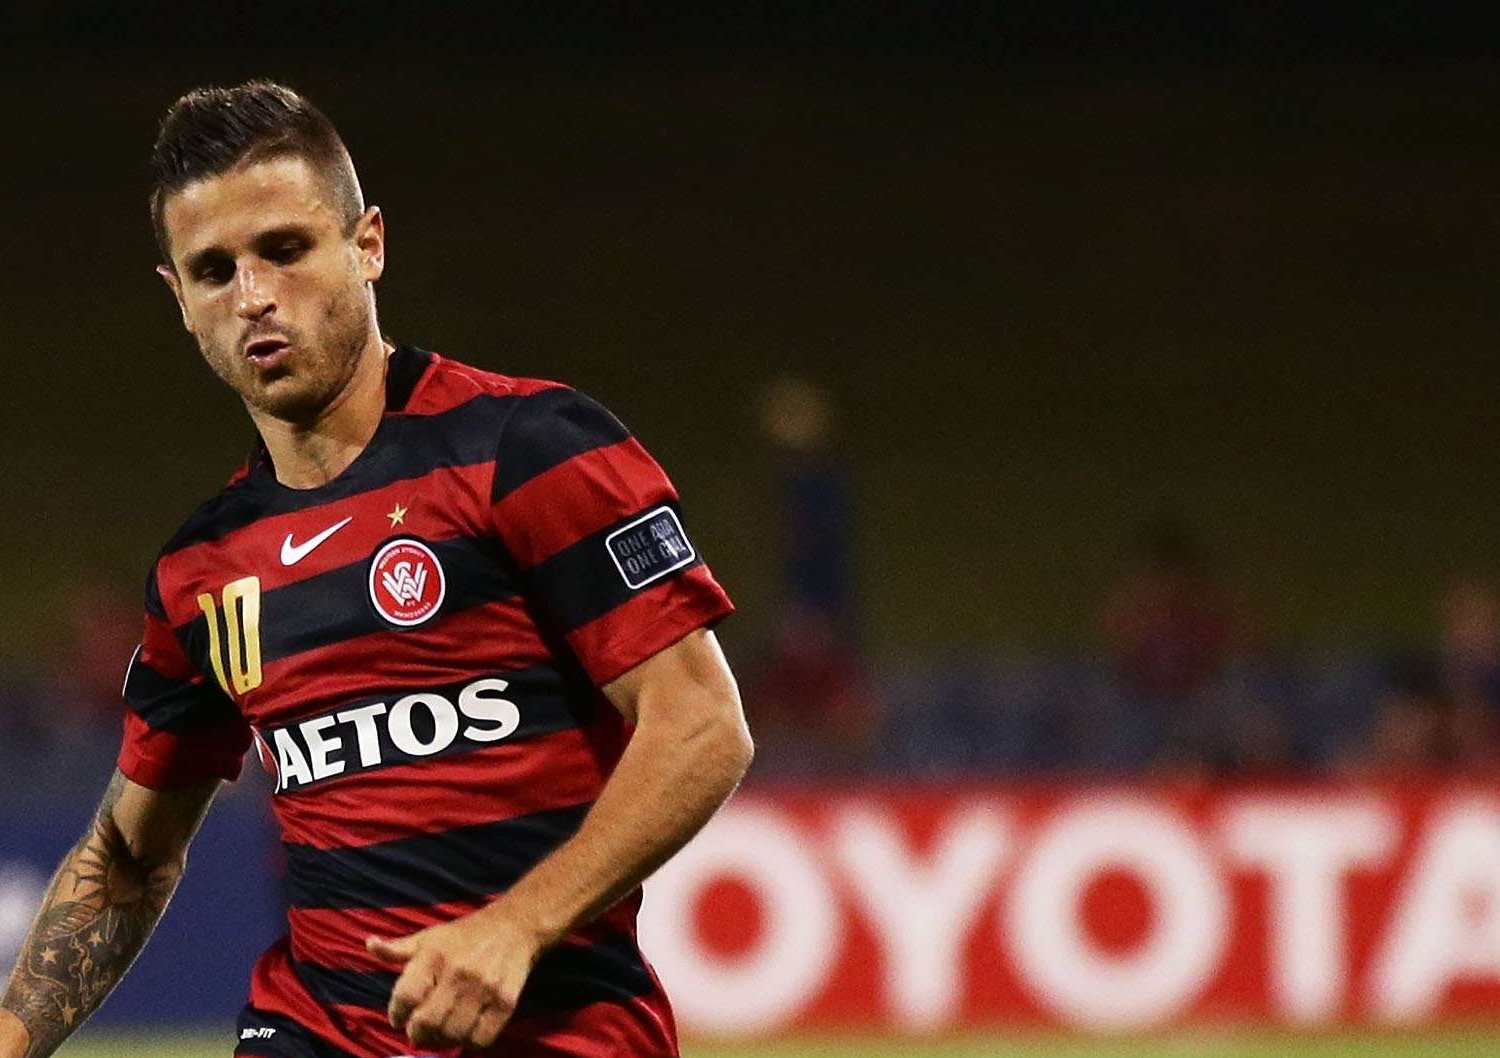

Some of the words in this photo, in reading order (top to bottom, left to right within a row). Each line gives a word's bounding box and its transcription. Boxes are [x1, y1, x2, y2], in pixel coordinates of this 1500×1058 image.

[617, 530, 649, 557] ONE
[626, 548, 659, 574] ONE
[197, 576, 262, 701] 10
[273, 678, 520, 790] AETOS
[638, 802, 1500, 1030] OYOTA
